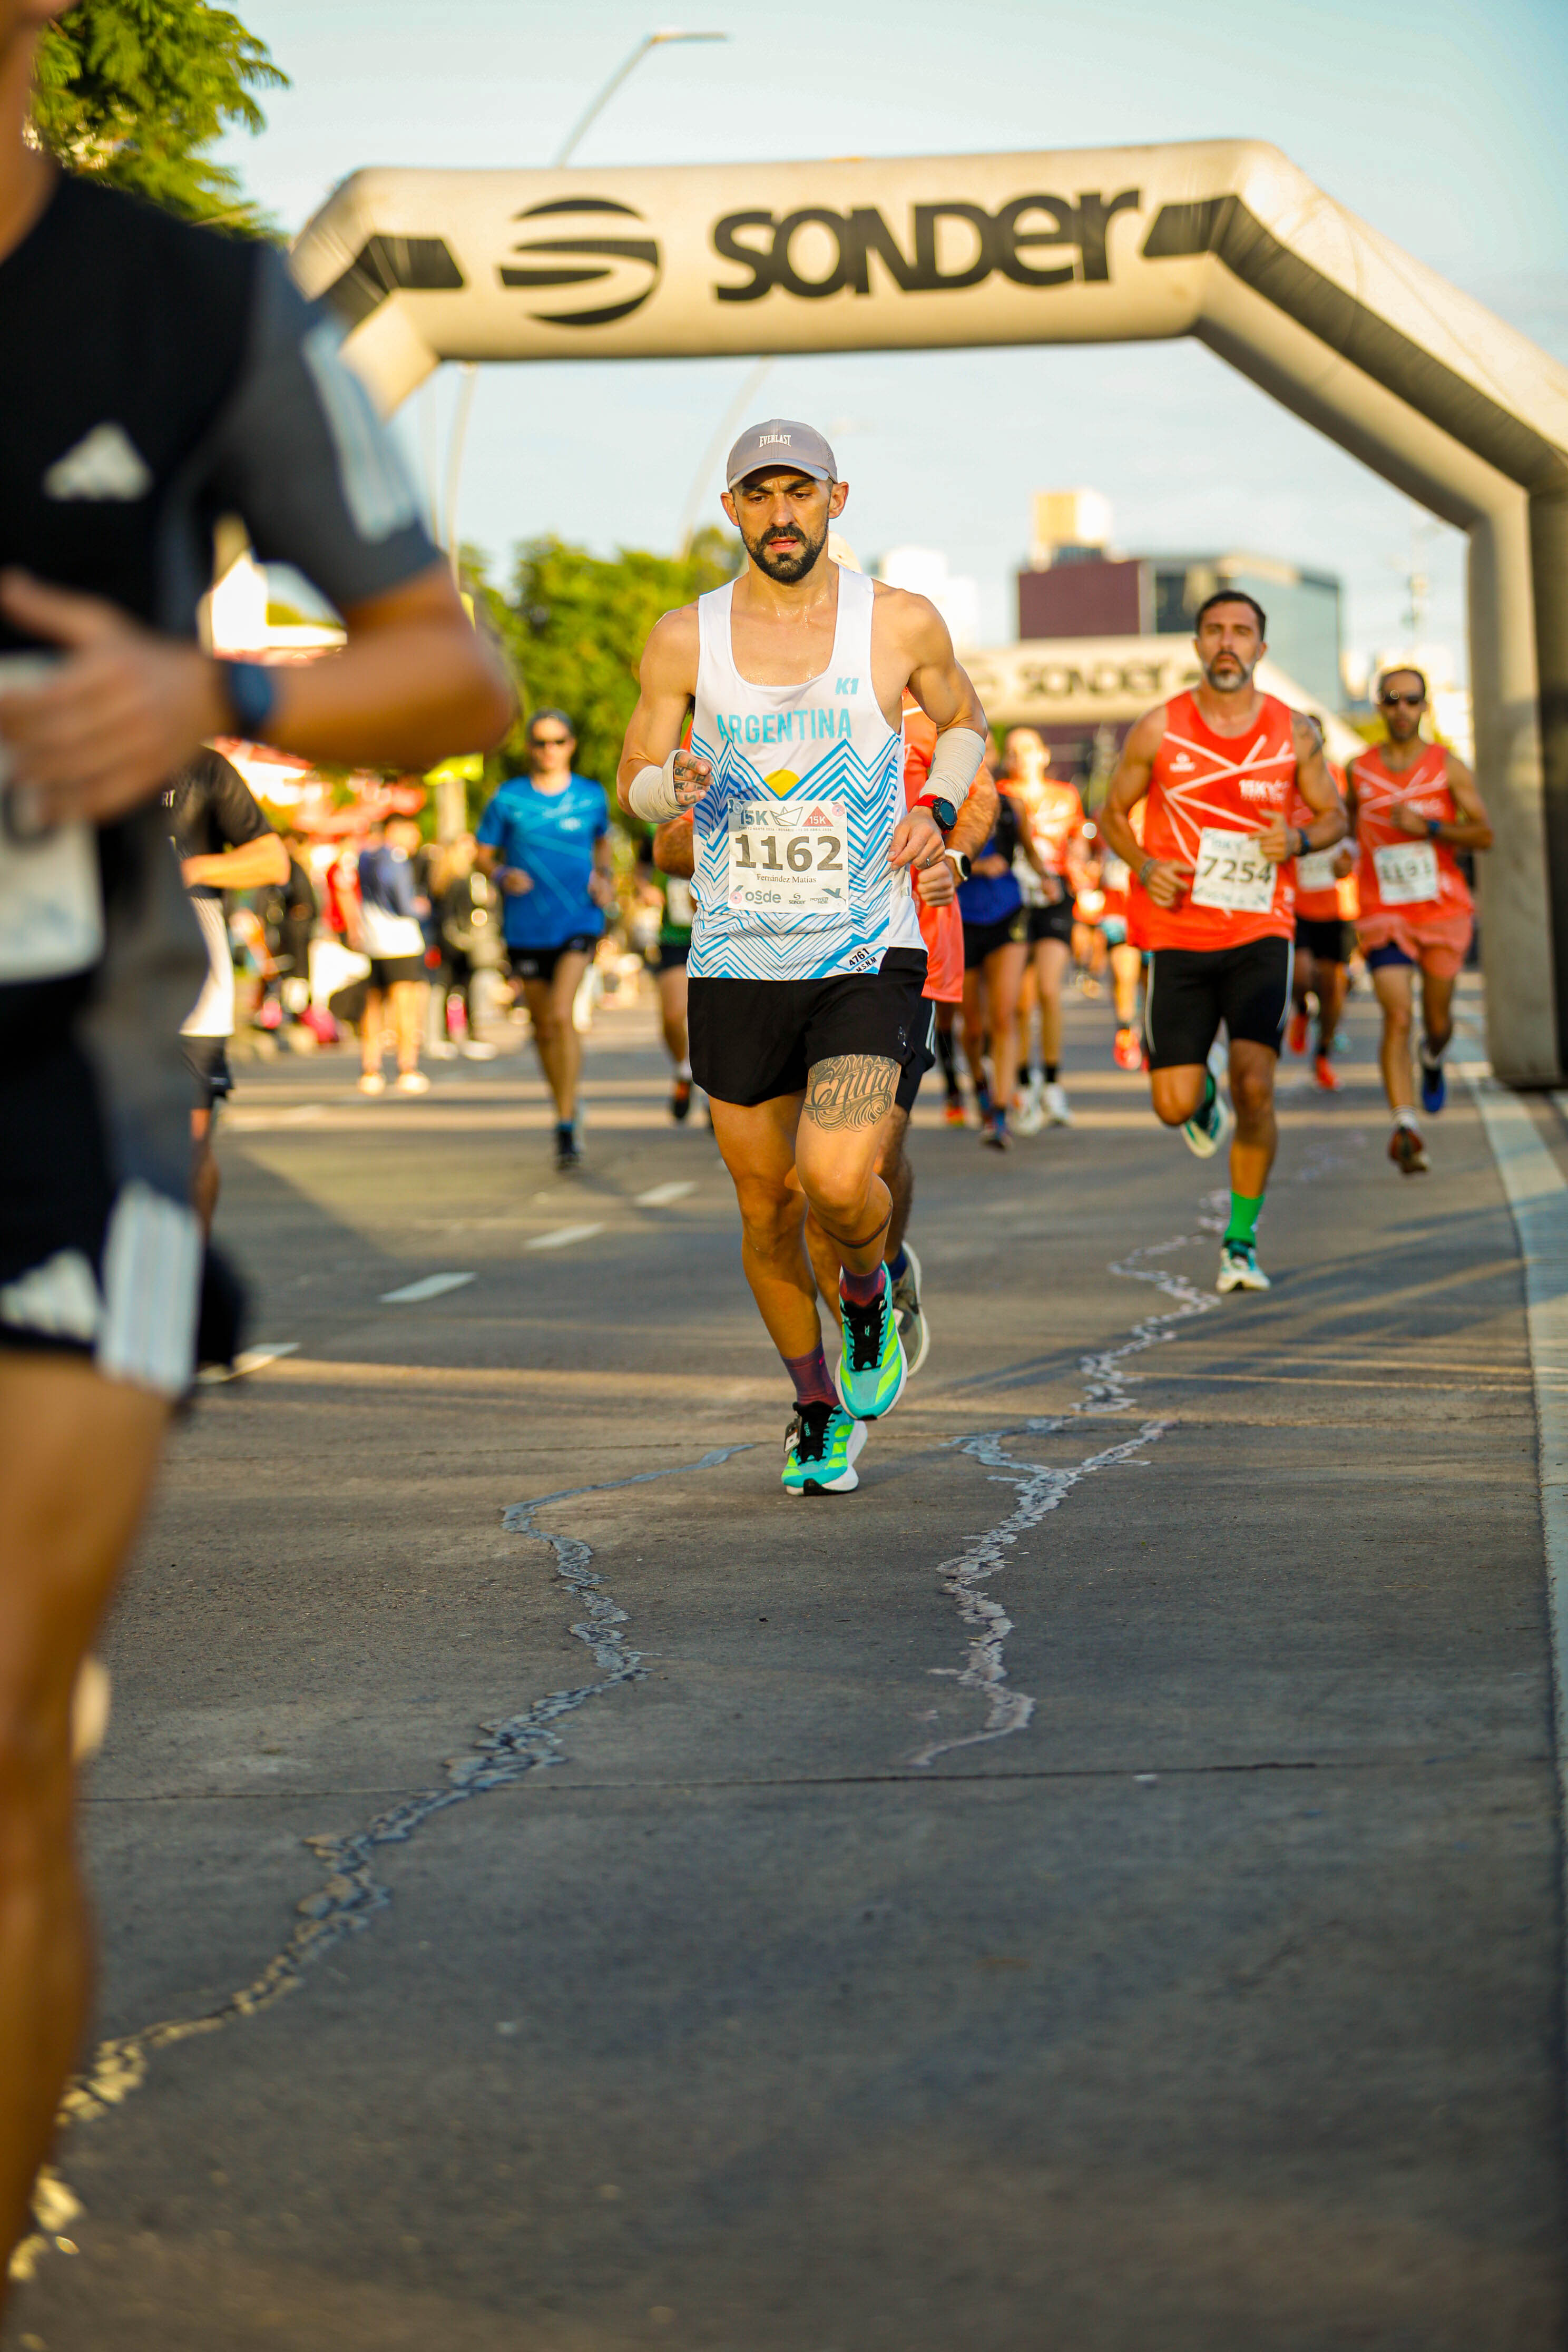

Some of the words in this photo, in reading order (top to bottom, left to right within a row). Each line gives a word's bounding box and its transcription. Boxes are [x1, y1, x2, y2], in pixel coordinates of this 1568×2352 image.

[759, 435, 791, 448] EVERLAST
[835, 677, 859, 695] K1
[717, 708, 852, 744] ARGENTINA
[740, 809, 769, 825] 15K
[809, 816, 827, 824] 15K
[735, 834, 843, 872] 1162
[757, 874, 790, 883] Fernández
[1202, 855, 1272, 884] 7254
[849, 948, 870, 966] 4761
